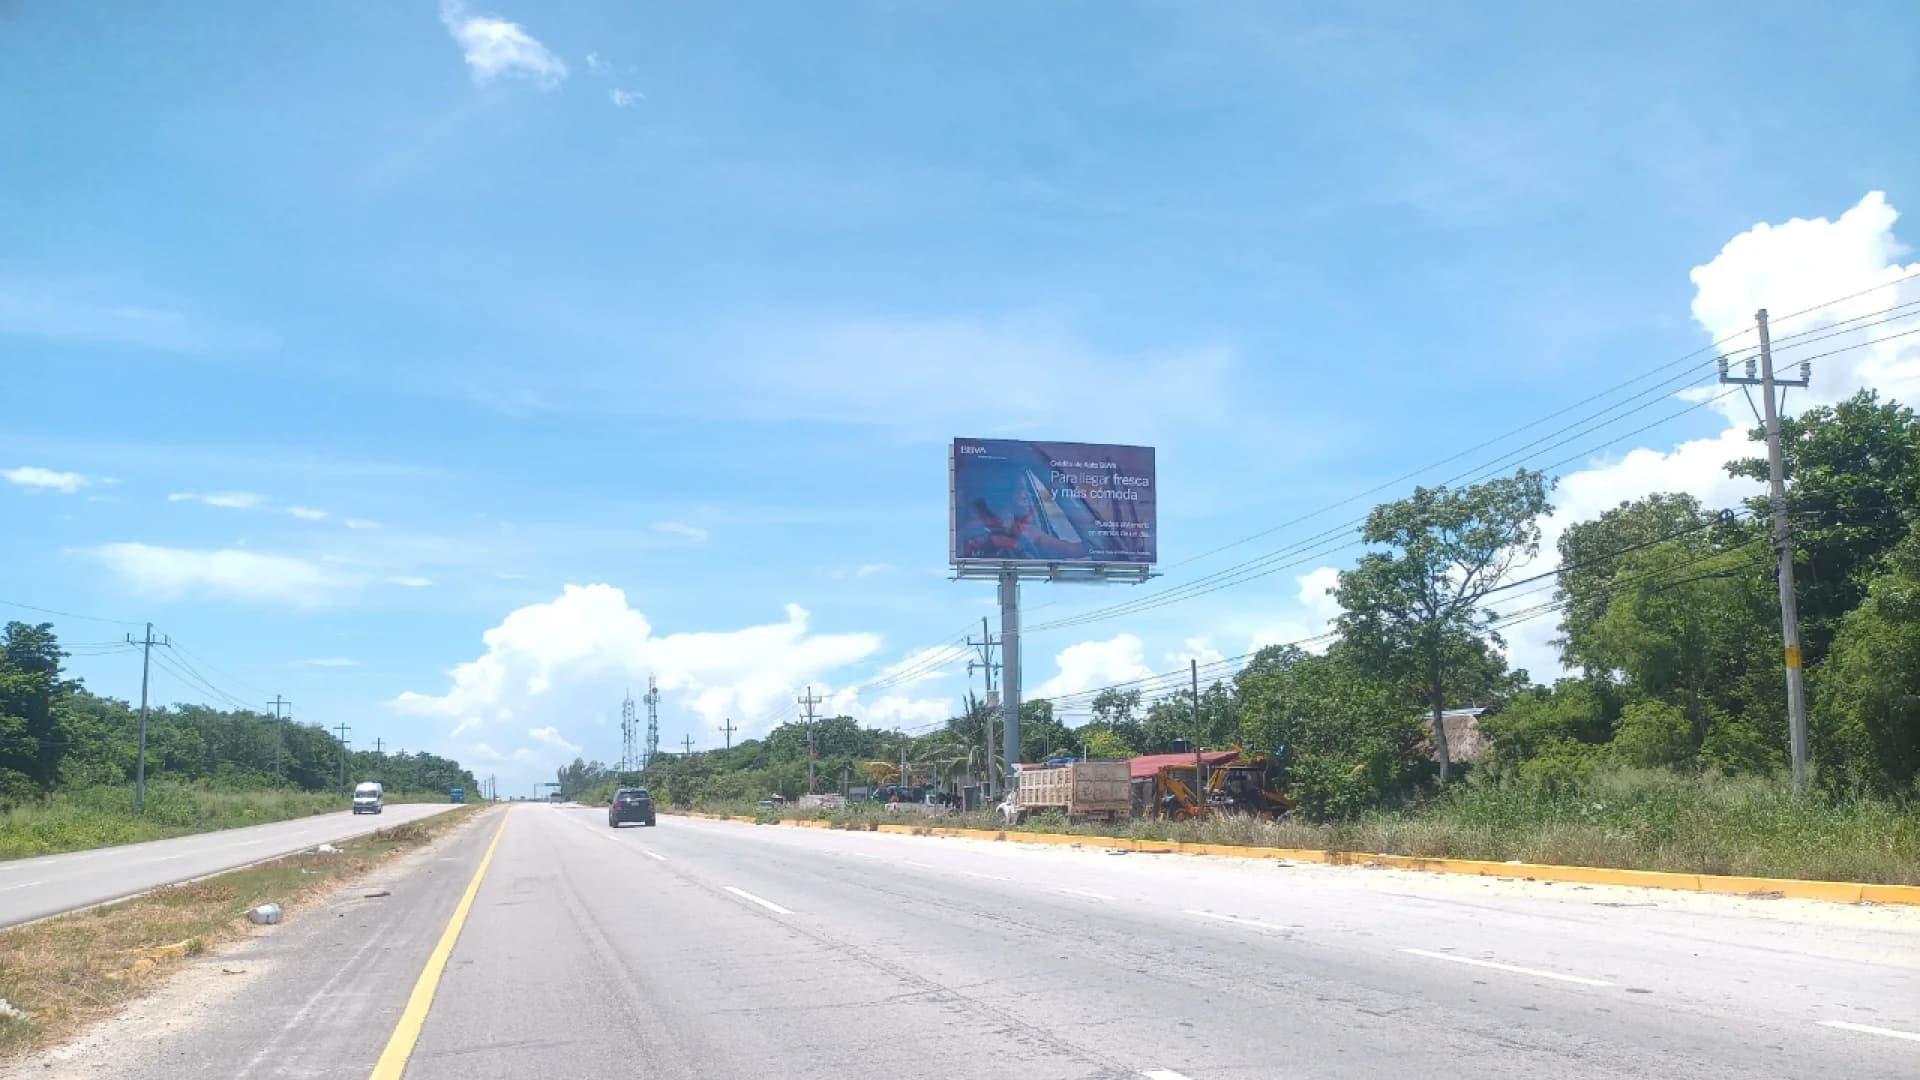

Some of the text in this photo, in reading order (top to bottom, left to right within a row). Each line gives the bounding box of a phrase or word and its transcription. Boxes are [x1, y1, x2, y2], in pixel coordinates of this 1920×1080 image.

[960, 446, 986, 454] BBVA
[1050, 470, 1150, 487] Para llegar fresca
[1050, 486, 1138, 501] y más cómoda
